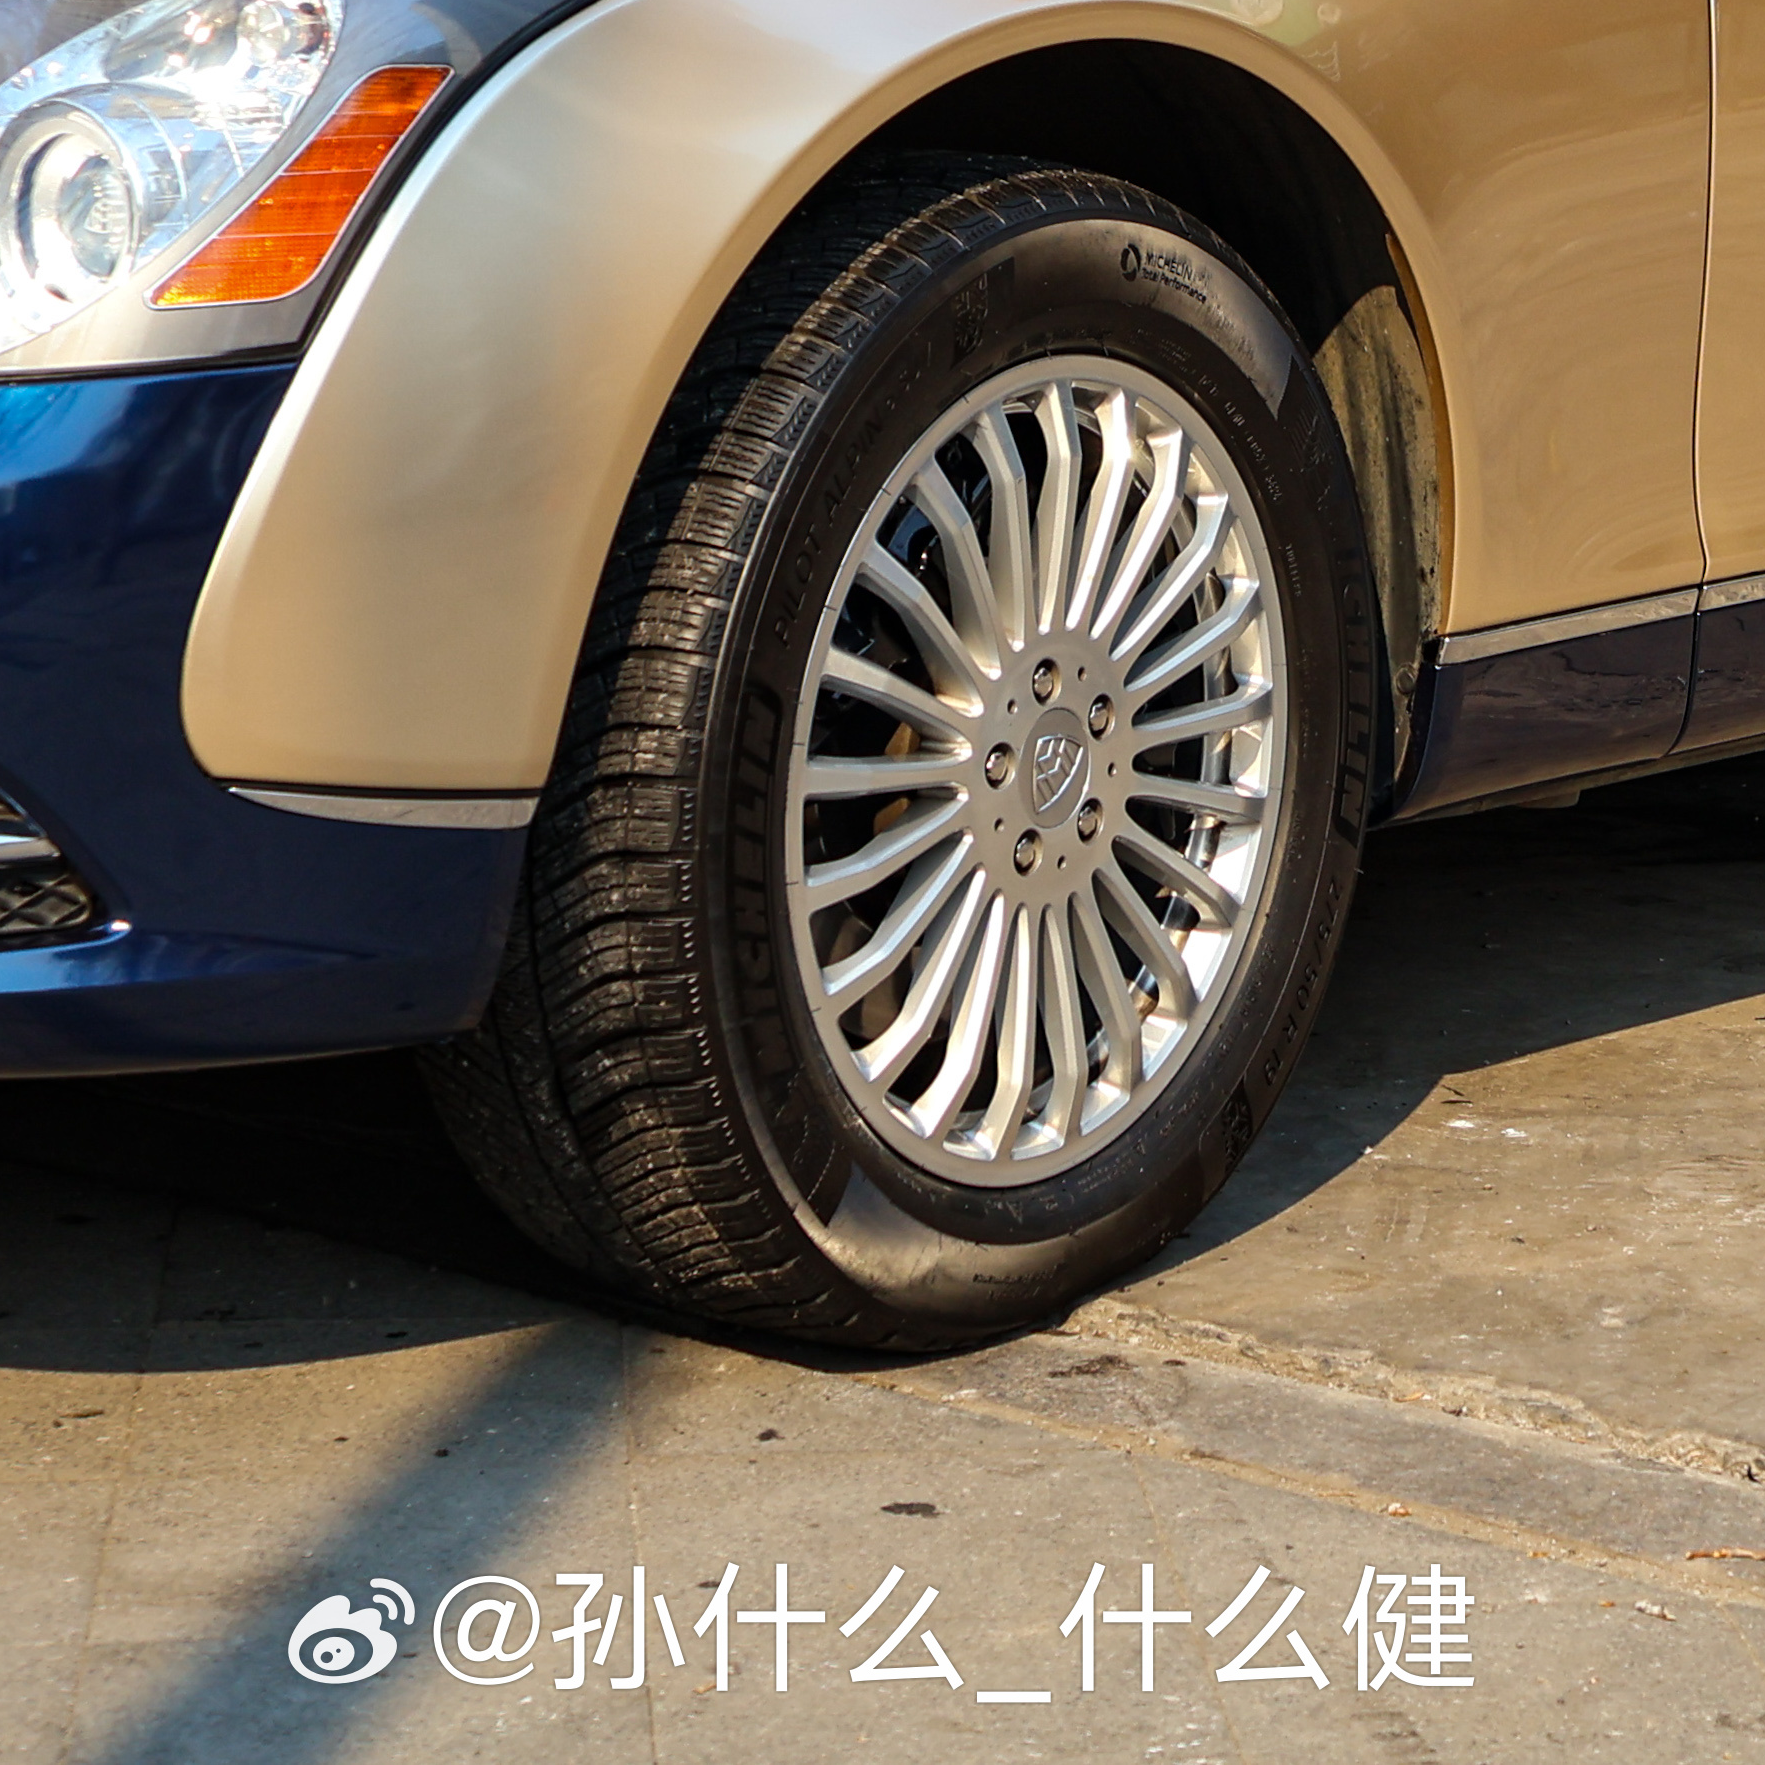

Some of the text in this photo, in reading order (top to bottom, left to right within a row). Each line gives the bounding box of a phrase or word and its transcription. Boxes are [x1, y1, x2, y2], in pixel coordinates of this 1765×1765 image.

[1144, 247, 1193, 283] MICHELIN
[1158, 271, 1209, 306] Performance
[771, 525, 826, 652] PILOT
[1295, 880, 1343, 1012] 275/50
